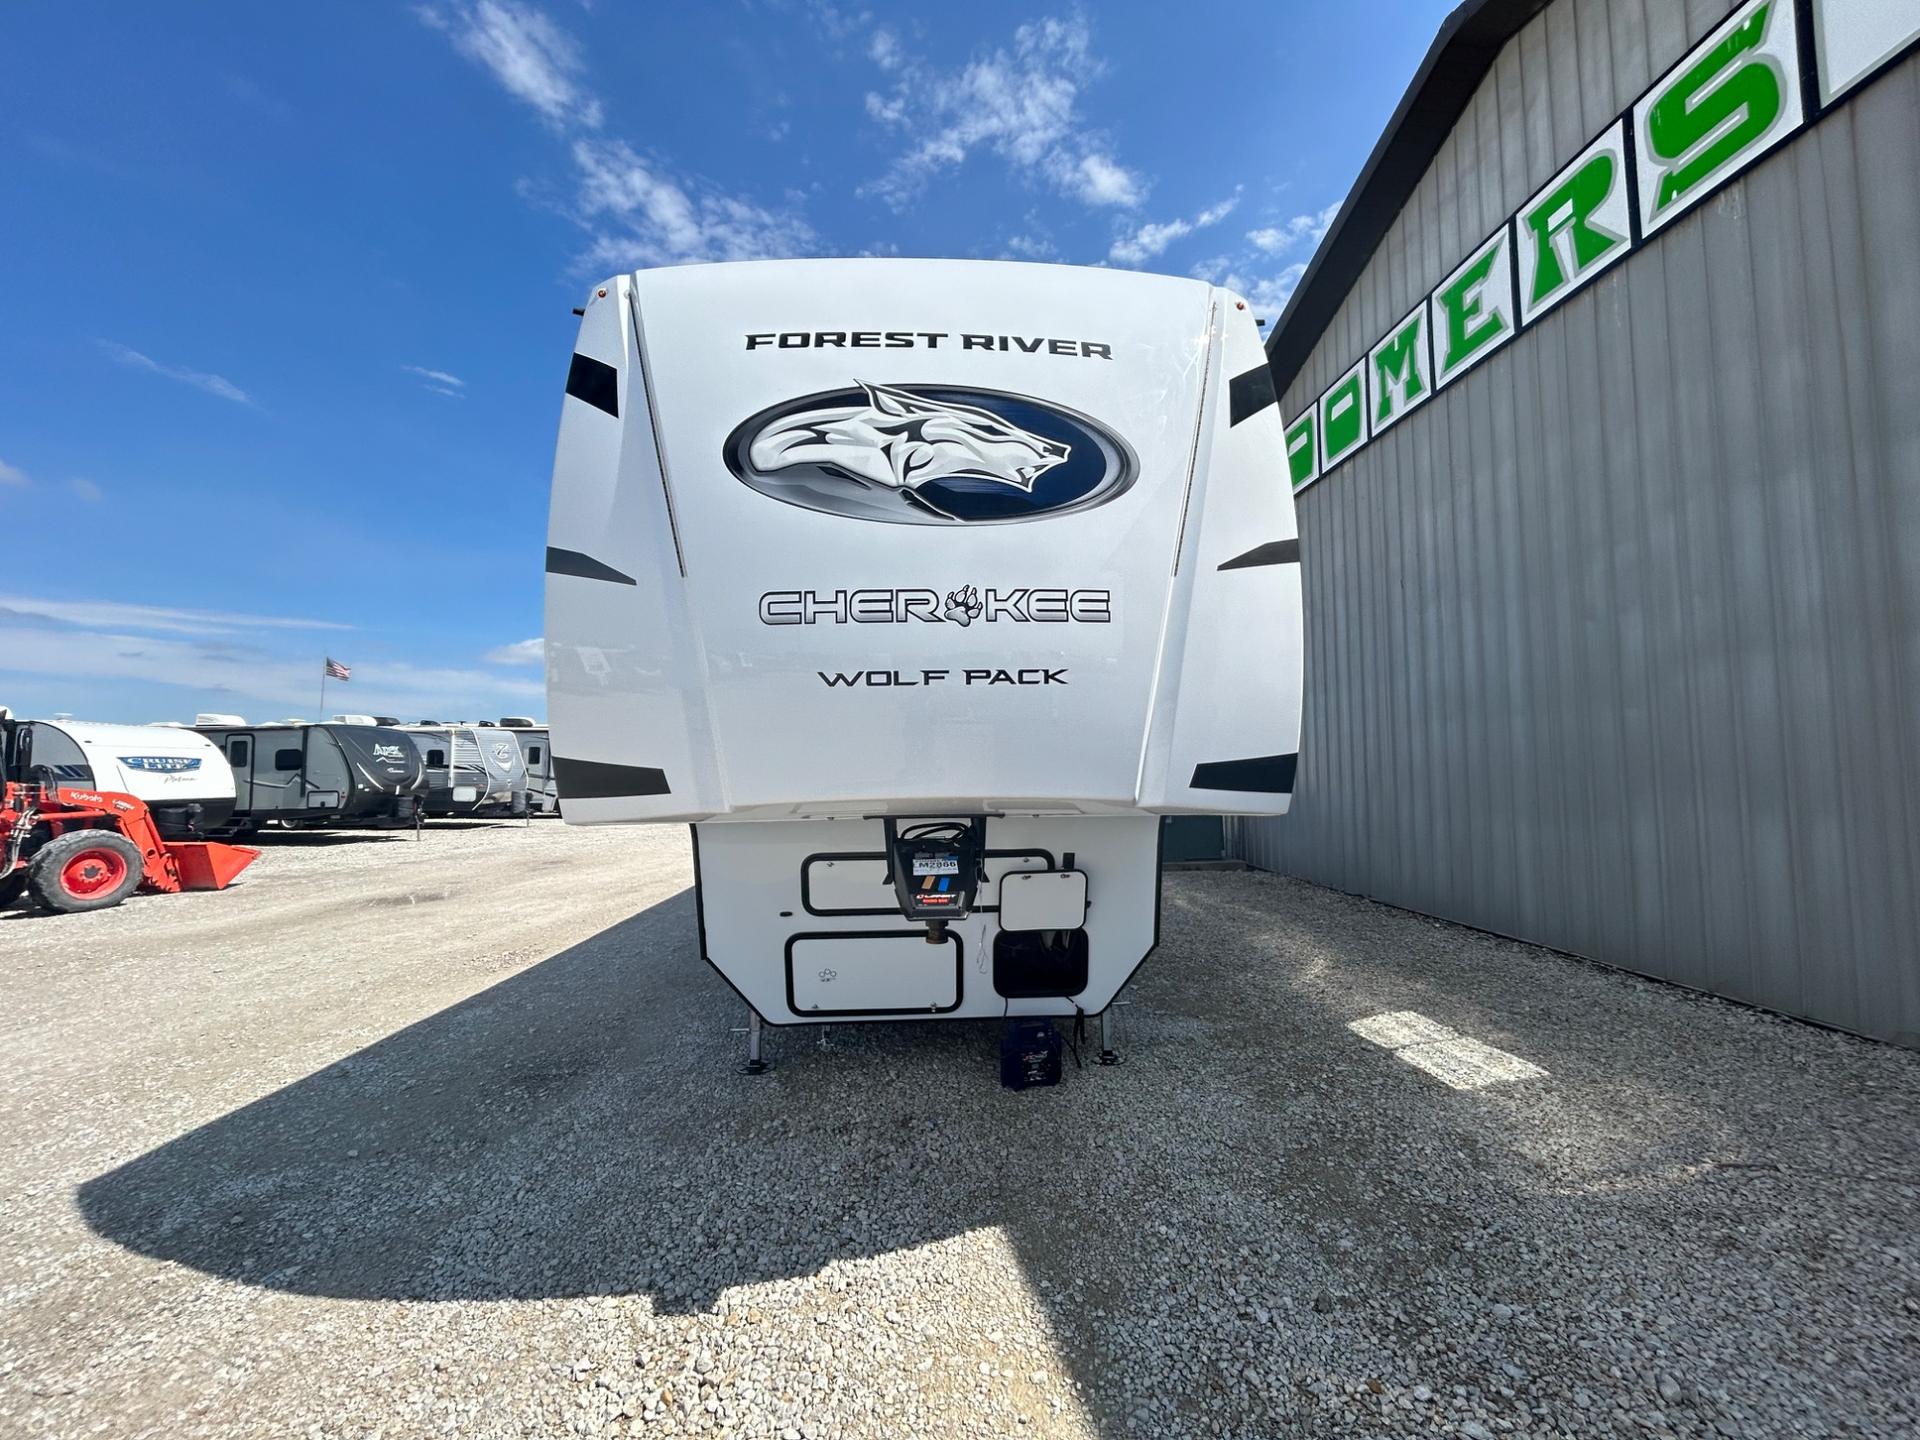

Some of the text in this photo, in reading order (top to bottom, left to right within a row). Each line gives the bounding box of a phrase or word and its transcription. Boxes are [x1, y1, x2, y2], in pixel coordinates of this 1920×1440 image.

[744, 331, 1114, 361] FOREST RIVER
[817, 668, 1069, 687] WOLF PACK
[69, 791, 104, 803] Kubota
